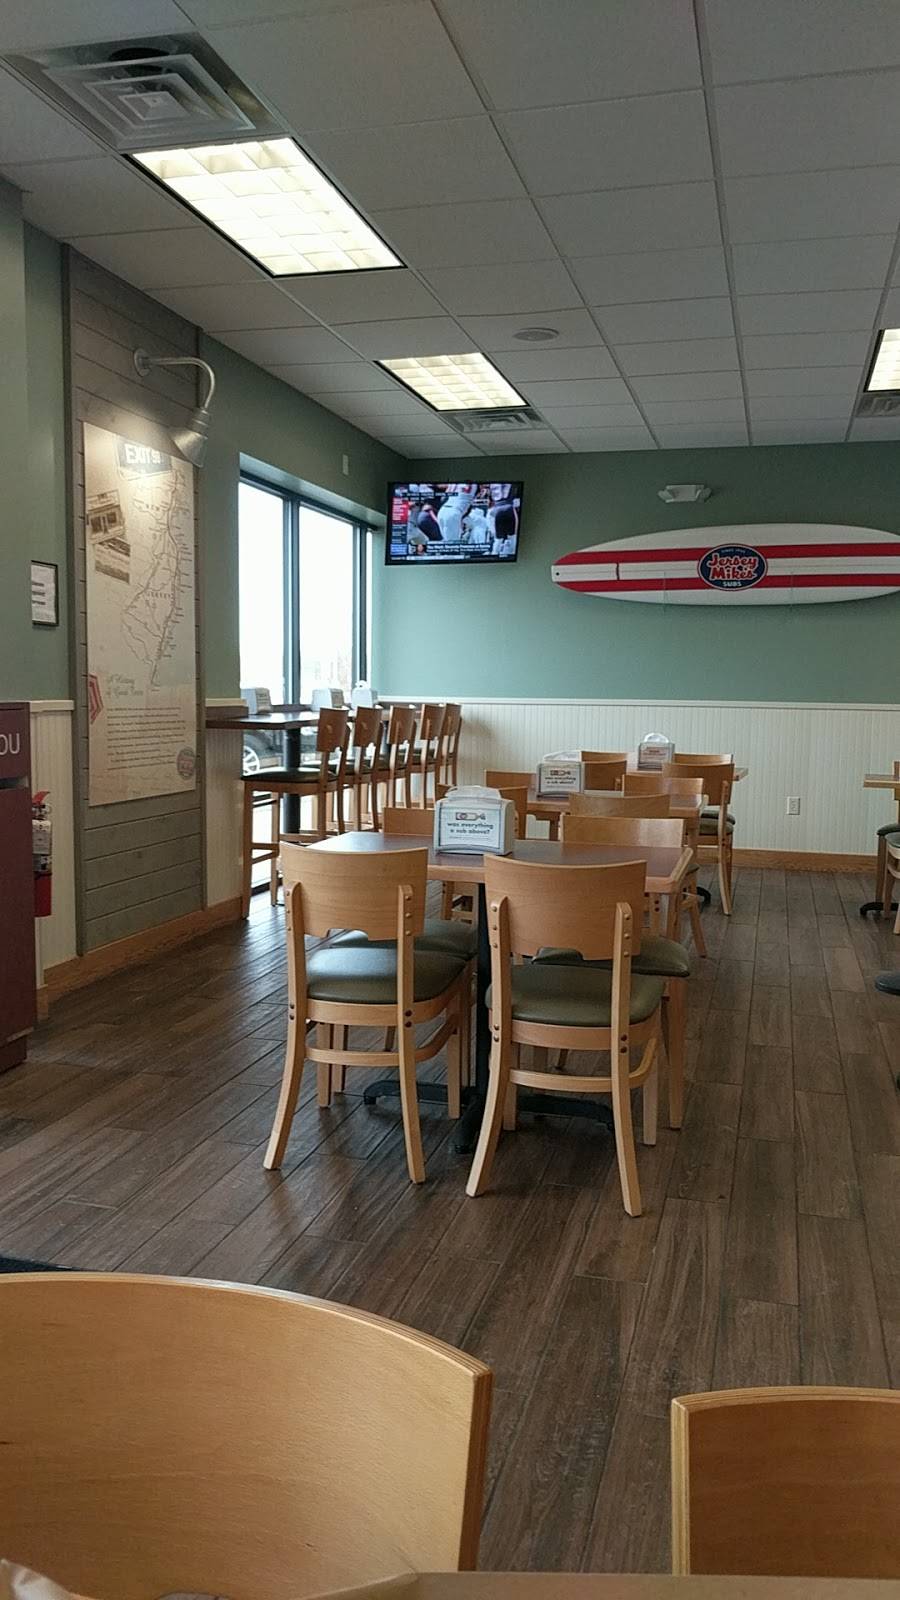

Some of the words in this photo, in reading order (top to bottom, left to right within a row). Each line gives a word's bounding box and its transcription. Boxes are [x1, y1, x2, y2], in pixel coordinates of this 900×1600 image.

[125, 444, 151, 464] EXIT
[706, 553, 758, 570] Jersey
[461, 822, 494, 830] everything
